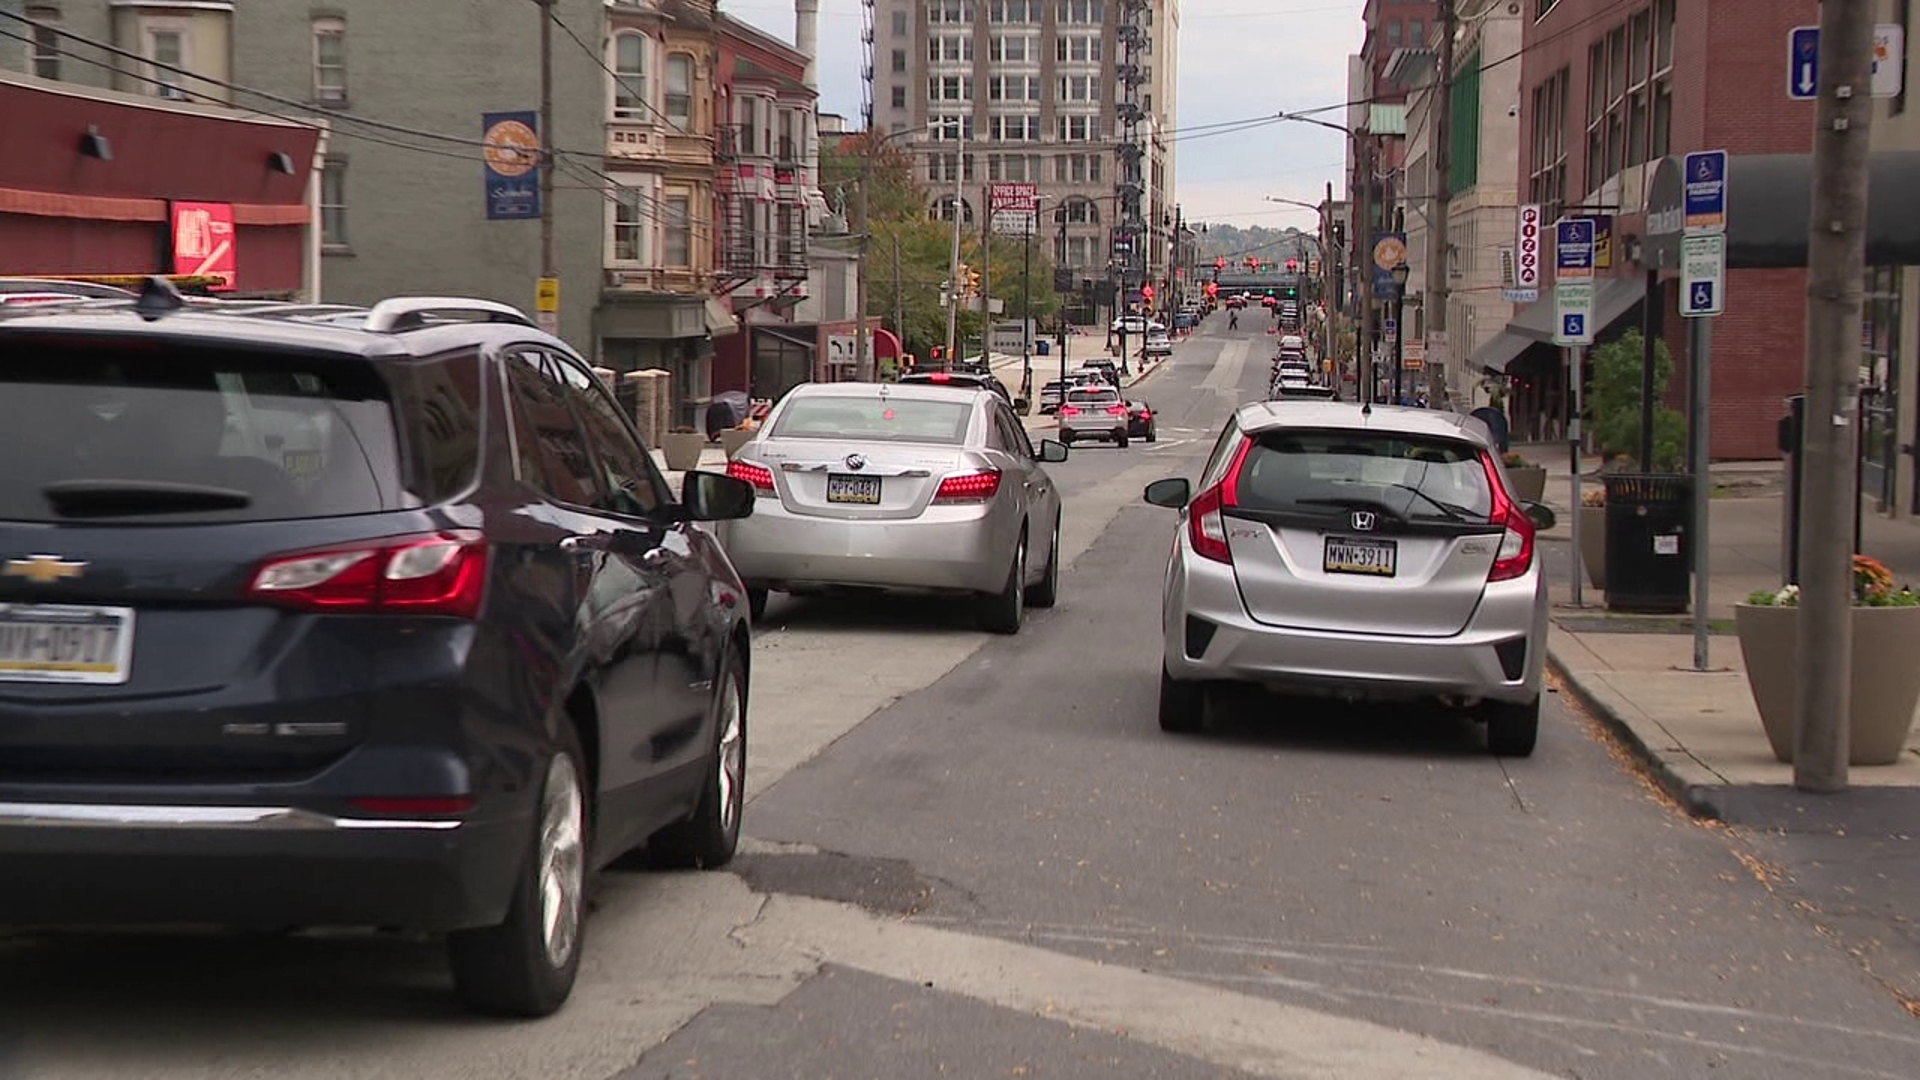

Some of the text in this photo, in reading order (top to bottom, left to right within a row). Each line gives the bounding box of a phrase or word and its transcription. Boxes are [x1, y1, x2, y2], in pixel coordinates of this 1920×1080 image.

[992, 185, 1035, 197] OFFICE SPACE
[992, 197, 1036, 208] AVAILABLE
[1522, 209, 1537, 283] PIZZA
